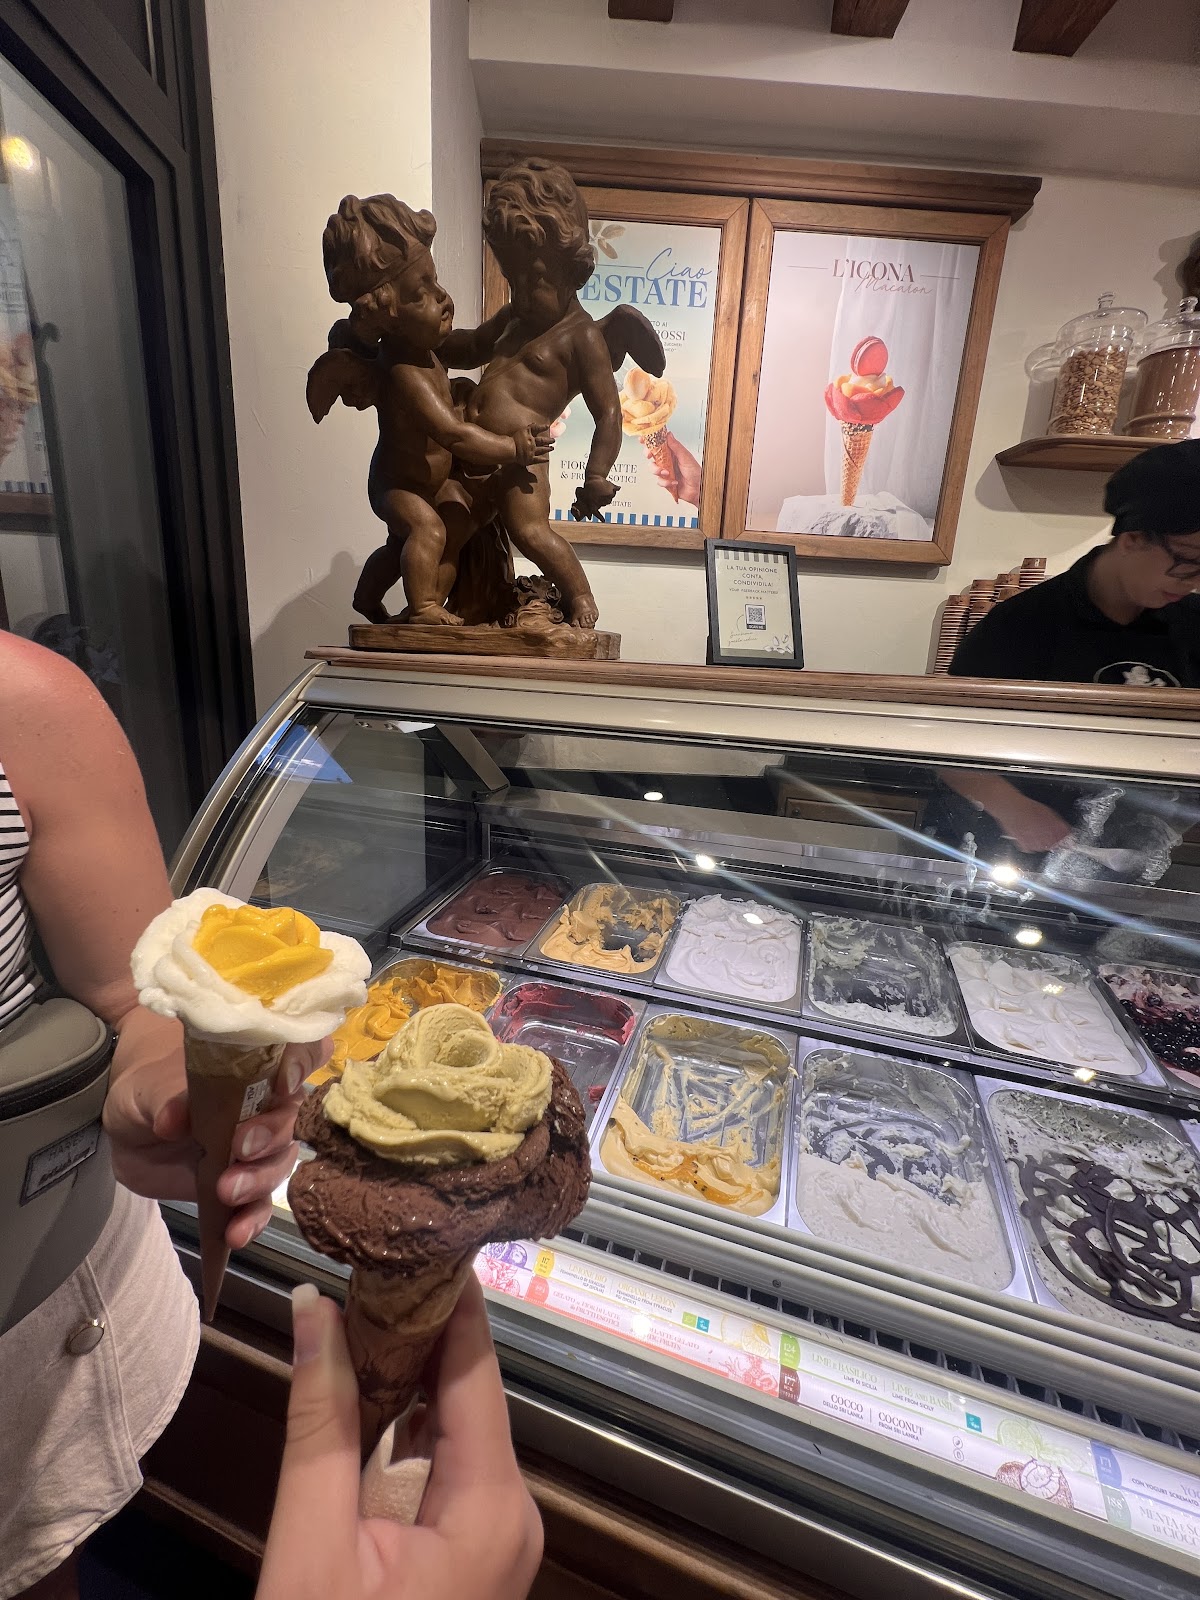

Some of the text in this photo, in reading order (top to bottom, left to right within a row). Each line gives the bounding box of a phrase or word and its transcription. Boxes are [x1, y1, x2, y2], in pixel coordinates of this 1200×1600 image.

[646, 248, 712, 281] Ciao
[832, 258, 914, 282] L'ICONA
[580, 274, 708, 308] ESTATE
[855, 272, 933, 294] Macaron
[610, 464, 638, 474] ATTE
[608, 475, 636, 484] SOTICI
[839, 1363, 877, 1383] BASILICO
[862, 1381, 877, 1391] SICILIA
[823, 1400, 838, 1410] DELLO
[847, 1410, 863, 1420] LANKA
[831, 1394, 863, 1412] COCCO
[904, 1397, 918, 1406] FROM
[919, 1402, 934, 1412] SICILY
[878, 1422, 892, 1431] FROM
[902, 1430, 919, 1441] LANKA
[879, 1412, 924, 1435] COCONUT
[1132, 1478, 1199, 1506] CON YOGURT SCREMATO
[1140, 1506, 1179, 1530] MENTA
